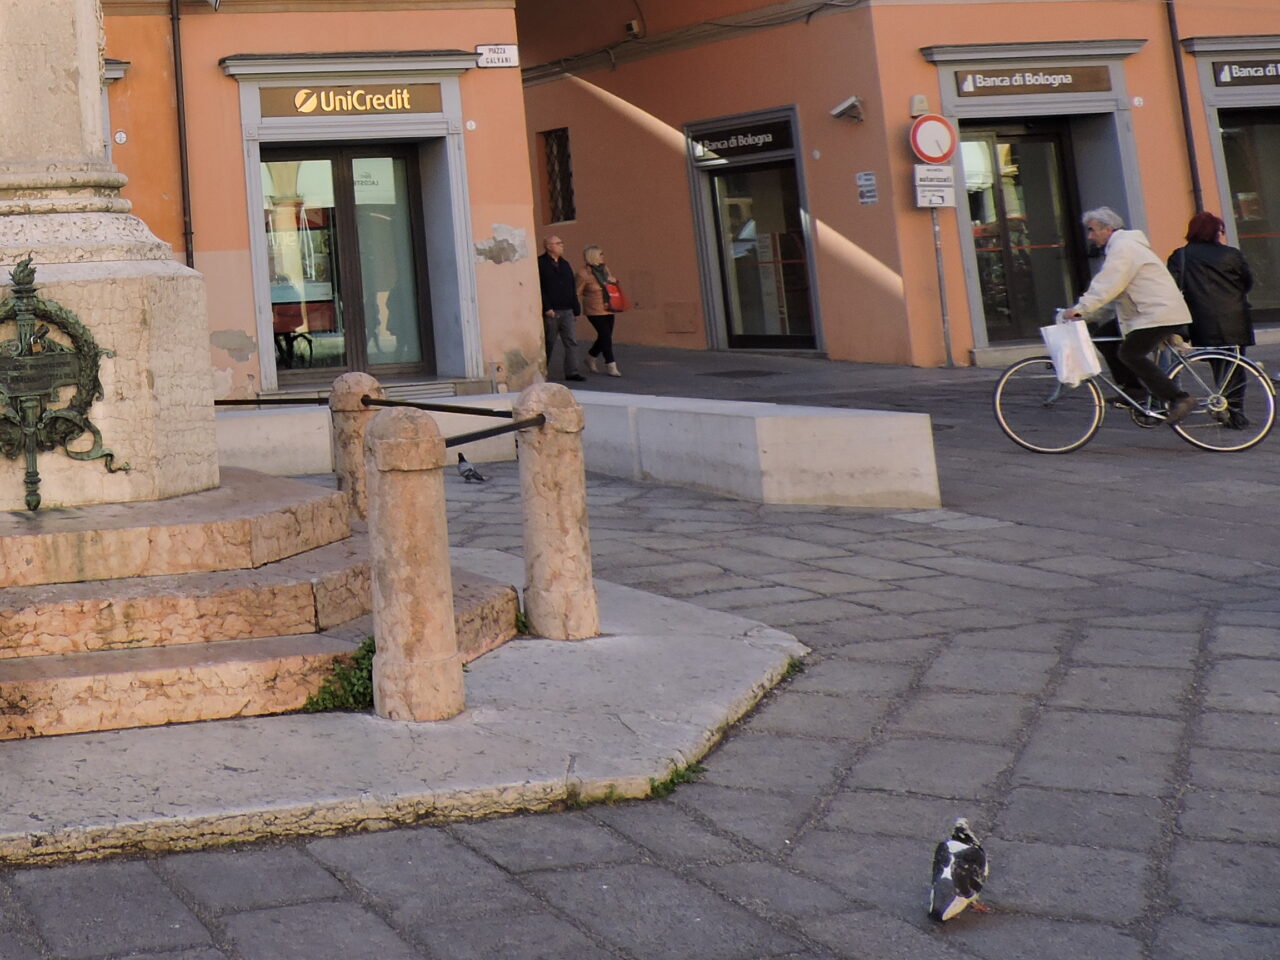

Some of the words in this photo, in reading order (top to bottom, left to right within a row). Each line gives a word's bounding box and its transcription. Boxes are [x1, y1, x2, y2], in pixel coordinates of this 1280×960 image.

[1231, 65, 1264, 77] Banca
[1265, 63, 1277, 76] di
[976, 74, 1010, 87] Banca
[1012, 73, 1023, 86] di
[1025, 72, 1073, 87] Bologna
[320, 88, 411, 111] UniCredit
[704, 140, 728, 150] Banca
[729, 136, 737, 147] di
[738, 133, 773, 147] Bologna
